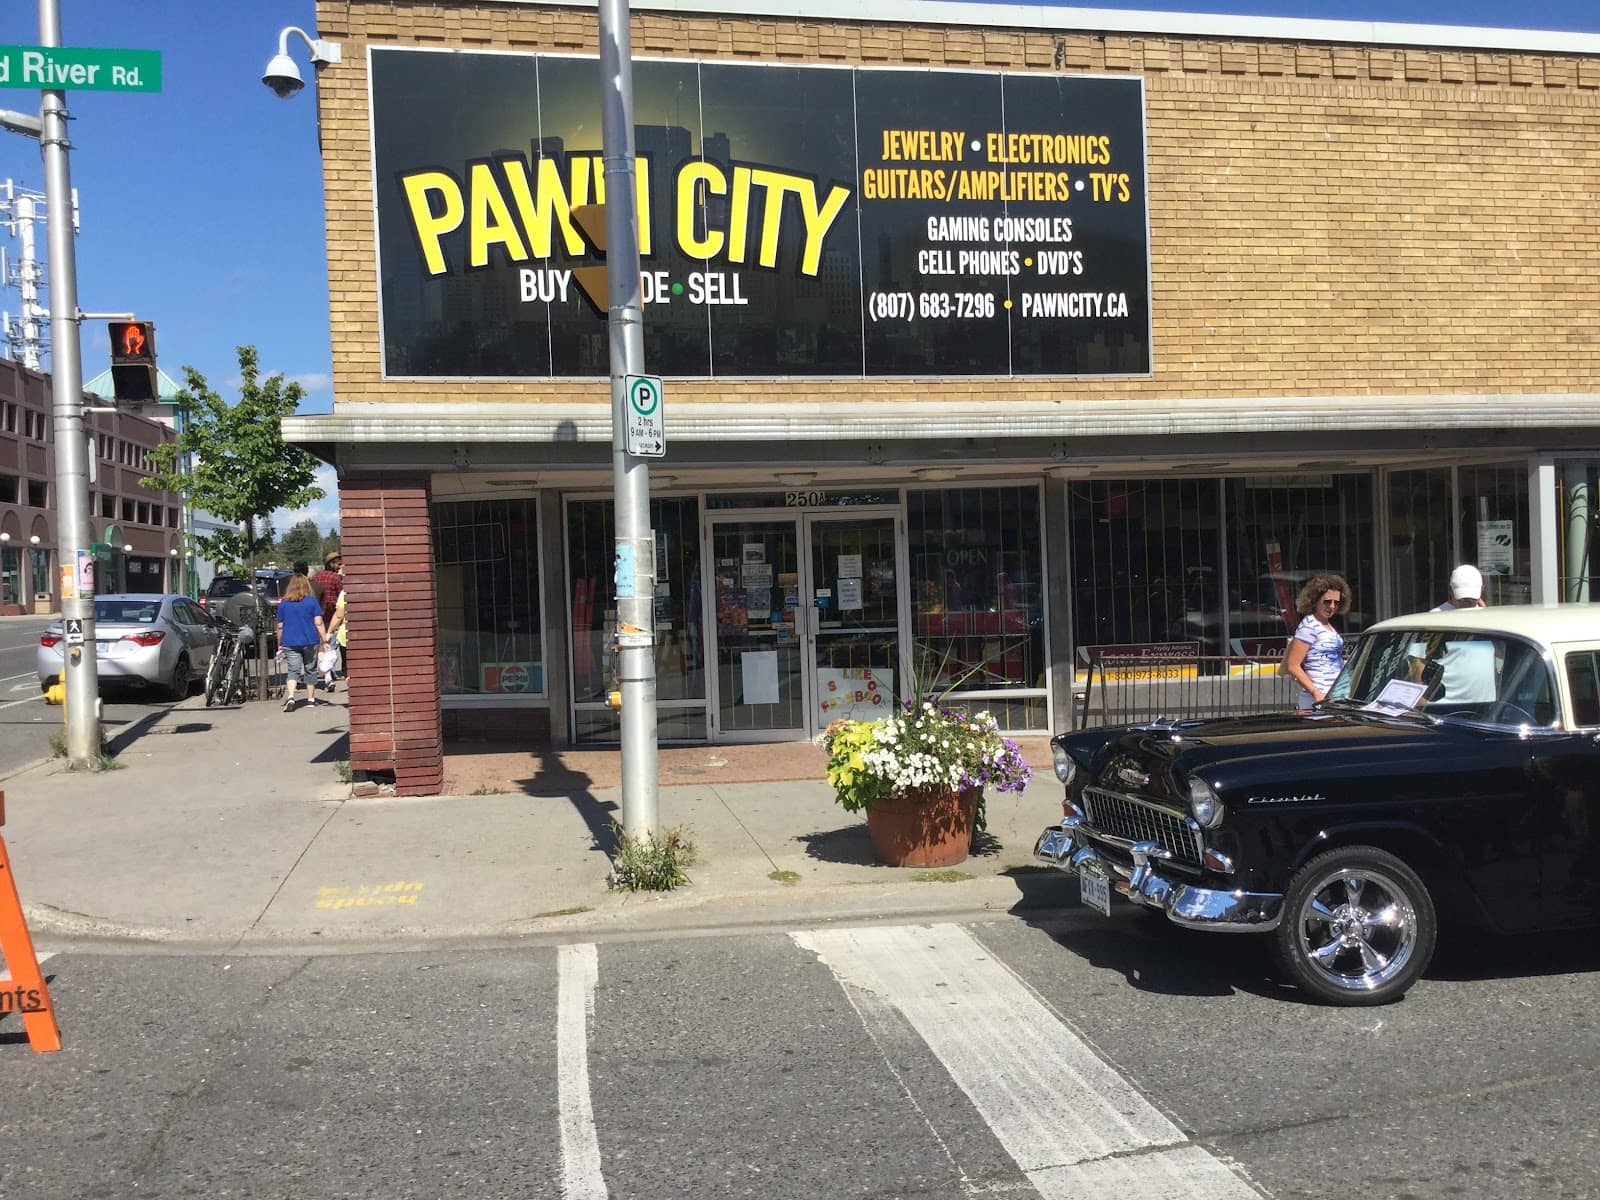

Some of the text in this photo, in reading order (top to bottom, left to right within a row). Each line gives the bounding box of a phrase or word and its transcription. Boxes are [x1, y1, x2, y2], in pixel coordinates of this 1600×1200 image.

[23, 51, 100, 85] River
[112, 65, 144, 86] Rd.
[881, 130, 1111, 165] JEWELRY ELECTRONICS
[863, 169, 1131, 202] GUITARS/AMPLIFIERS TV'S
[676, 160, 851, 277] CITY
[927, 216, 1073, 242] GAMING CONSOLES
[918, 250, 1083, 275] CELL PHONES DVD'S
[519, 269, 571, 303] BUY
[688, 272, 748, 305] SELL
[868, 292, 1129, 322] (807) 683-7296 PAWNCITY.CA
[639, 387, 650, 407] P
[631, 427, 635, 437] 9
[648, 428, 653, 438] 6
[638, 416, 653, 427] 2 hrs
[946, 549, 988, 566] OPEN
